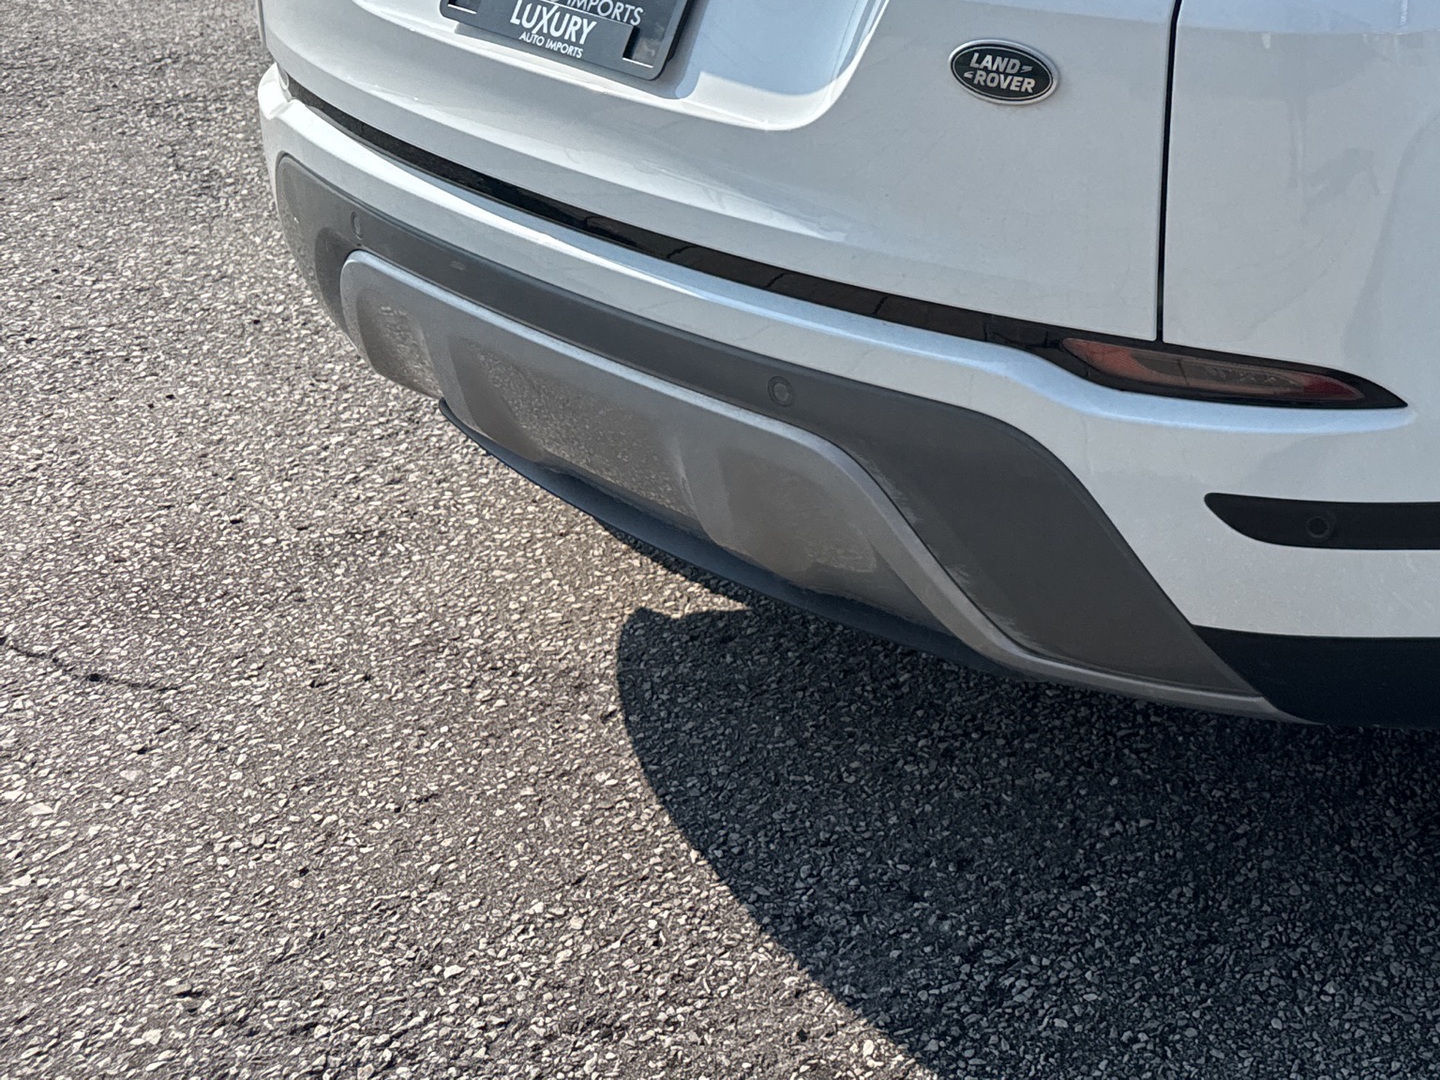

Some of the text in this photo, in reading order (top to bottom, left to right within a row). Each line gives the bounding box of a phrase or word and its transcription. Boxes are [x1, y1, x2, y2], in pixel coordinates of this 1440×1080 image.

[510, 0, 597, 45] LUXURY
[519, 32, 584, 59] AUTO IMPORTS
[969, 52, 1021, 74] LAND
[973, 69, 1036, 93] ROVER
